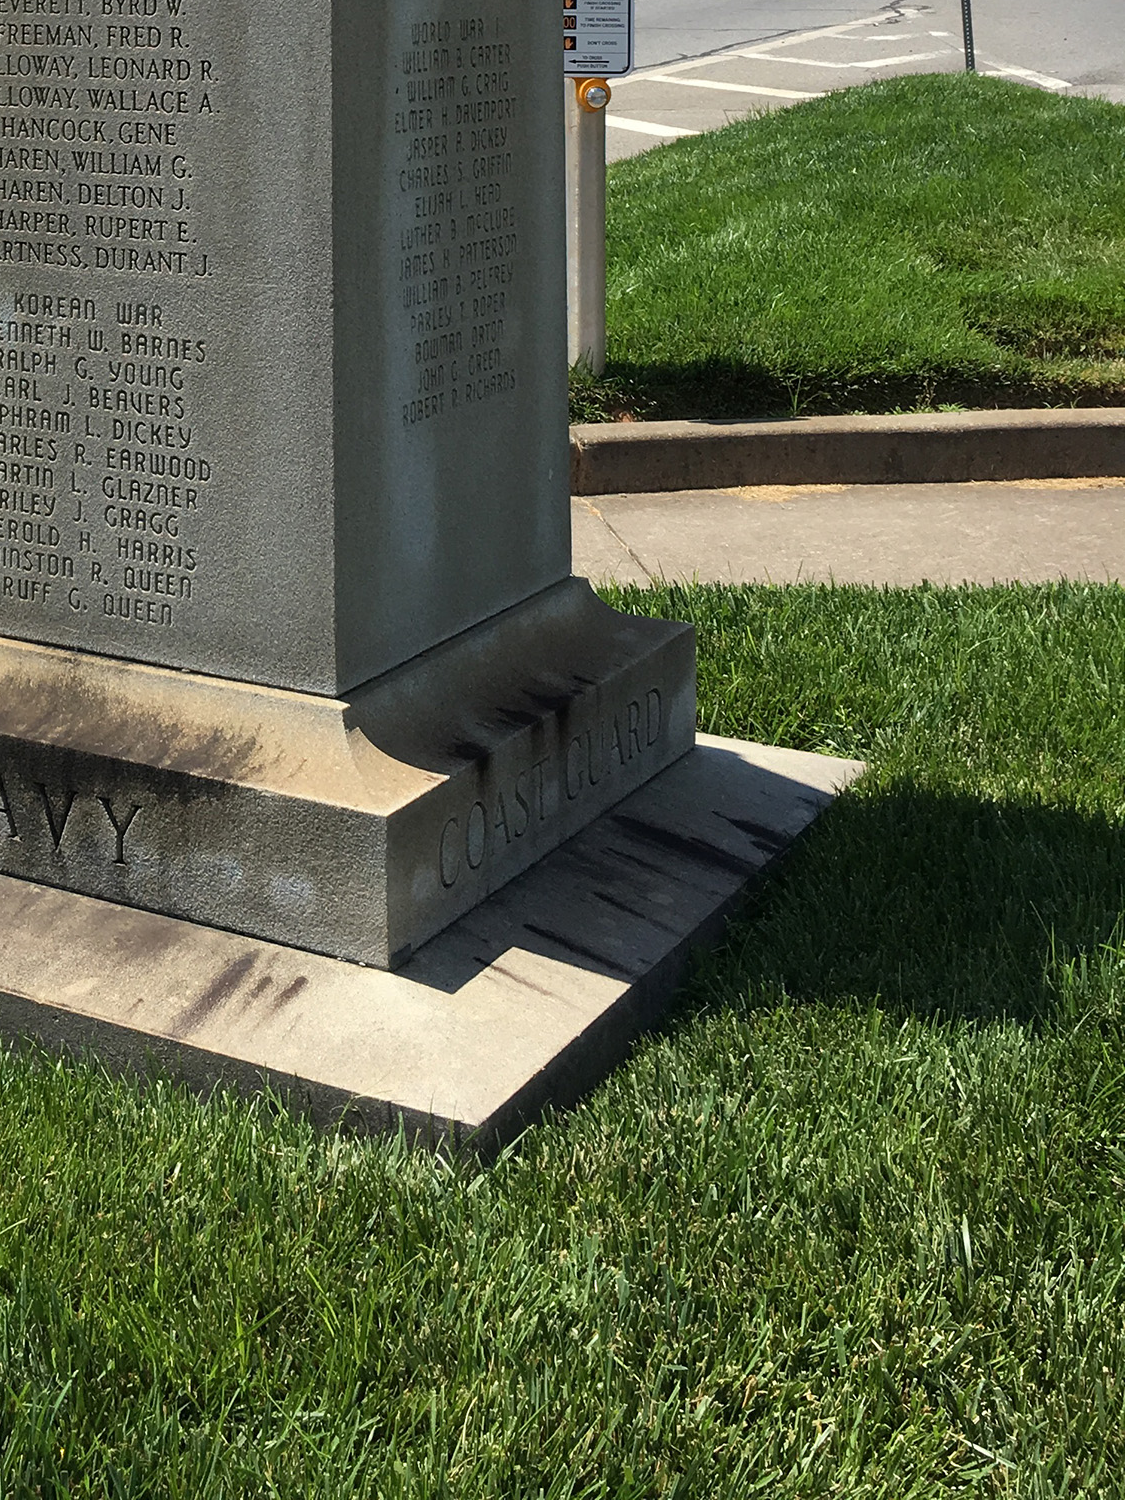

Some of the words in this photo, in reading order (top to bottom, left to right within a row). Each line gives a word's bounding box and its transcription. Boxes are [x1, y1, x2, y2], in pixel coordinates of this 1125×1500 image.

[106, 26, 161, 48] FRED
[171, 27, 189, 48] R.
[412, 21, 451, 45] WORLD
[460, 18, 484, 41] WAR
[88, 58, 191, 81] LEONARD
[201, 60, 219, 82] R.
[402, 48, 449, 75] WILLIAM
[470, 43, 511, 68] CARTER
[88, 88, 188, 114] WALLACE
[199, 93, 220, 114] A.
[407, 76, 455, 103] WILLIAM
[476, 72, 509, 95] CRAIG
[1, 117, 114, 144] HANCOCK,
[119, 122, 177, 146] GENE
[395, 109, 433, 133] ELMER
[456, 97, 516, 124] DAVENPORT
[407, 134, 448, 161] JASPER
[471, 126, 507, 151] DICKEY
[72, 151, 161, 177] WILLIAM
[171, 156, 192, 179] G.
[399, 164, 448, 192] CHARLES
[473, 152, 512, 179] GRIFFIN
[78, 184, 163, 209] DELTON
[171, 188, 190, 211] J.
[415, 191, 452, 218] ELIJAH
[475, 183, 501, 206] HEAD
[85, 216, 170, 242] RUPERT
[178, 222, 197, 244] E.
[401, 222, 441, 250] LUTHER
[95, 248, 187, 274] DURANT
[195, 254, 213, 278] J.
[399, 251, 435, 281] JAMES
[459, 233, 517, 267] PATTERSON
[14, 292, 95, 320] KOREAN
[117, 302, 163, 327] WAR
[403, 277, 448, 308] WILLIAM
[411, 305, 452, 334] PARLEY
[473, 292, 506, 317] ROPER
[88, 329, 108, 353] W.
[121, 333, 206, 363] BARNES
[415, 331, 462, 364] BOWMAN
[472, 319, 504, 348] ORTON
[75, 357, 94, 381] G.
[109, 361, 184, 390] YOUNG
[417, 364, 444, 394] JOHN
[62, 384, 76, 407] J.
[90, 388, 184, 419] BEAVERS
[403, 392, 444, 426] ROBERT
[86, 414, 100, 438] L.
[113, 419, 192, 449] DICKEY
[75, 443, 93, 466] R.
[107, 448, 211, 482] EARWOOD
[71, 472, 88, 496] L.
[103, 477, 197, 510] GLAZNER
[0, 489, 55, 516] RILEY
[73, 500, 87, 523] J.
[104, 505, 179, 537] GRAGG
[80, 531, 96, 554] H.
[118, 538, 197, 571] HARRIS
[91, 562, 108, 586] R.
[124, 567, 192, 599] QUEEN
[3, 576, 51, 604] RUFF
[69, 588, 87, 612] G.
[104, 594, 173, 626] QUEEN
[437, 755, 550, 890] COAST
[565, 687, 664, 802] GUARD
